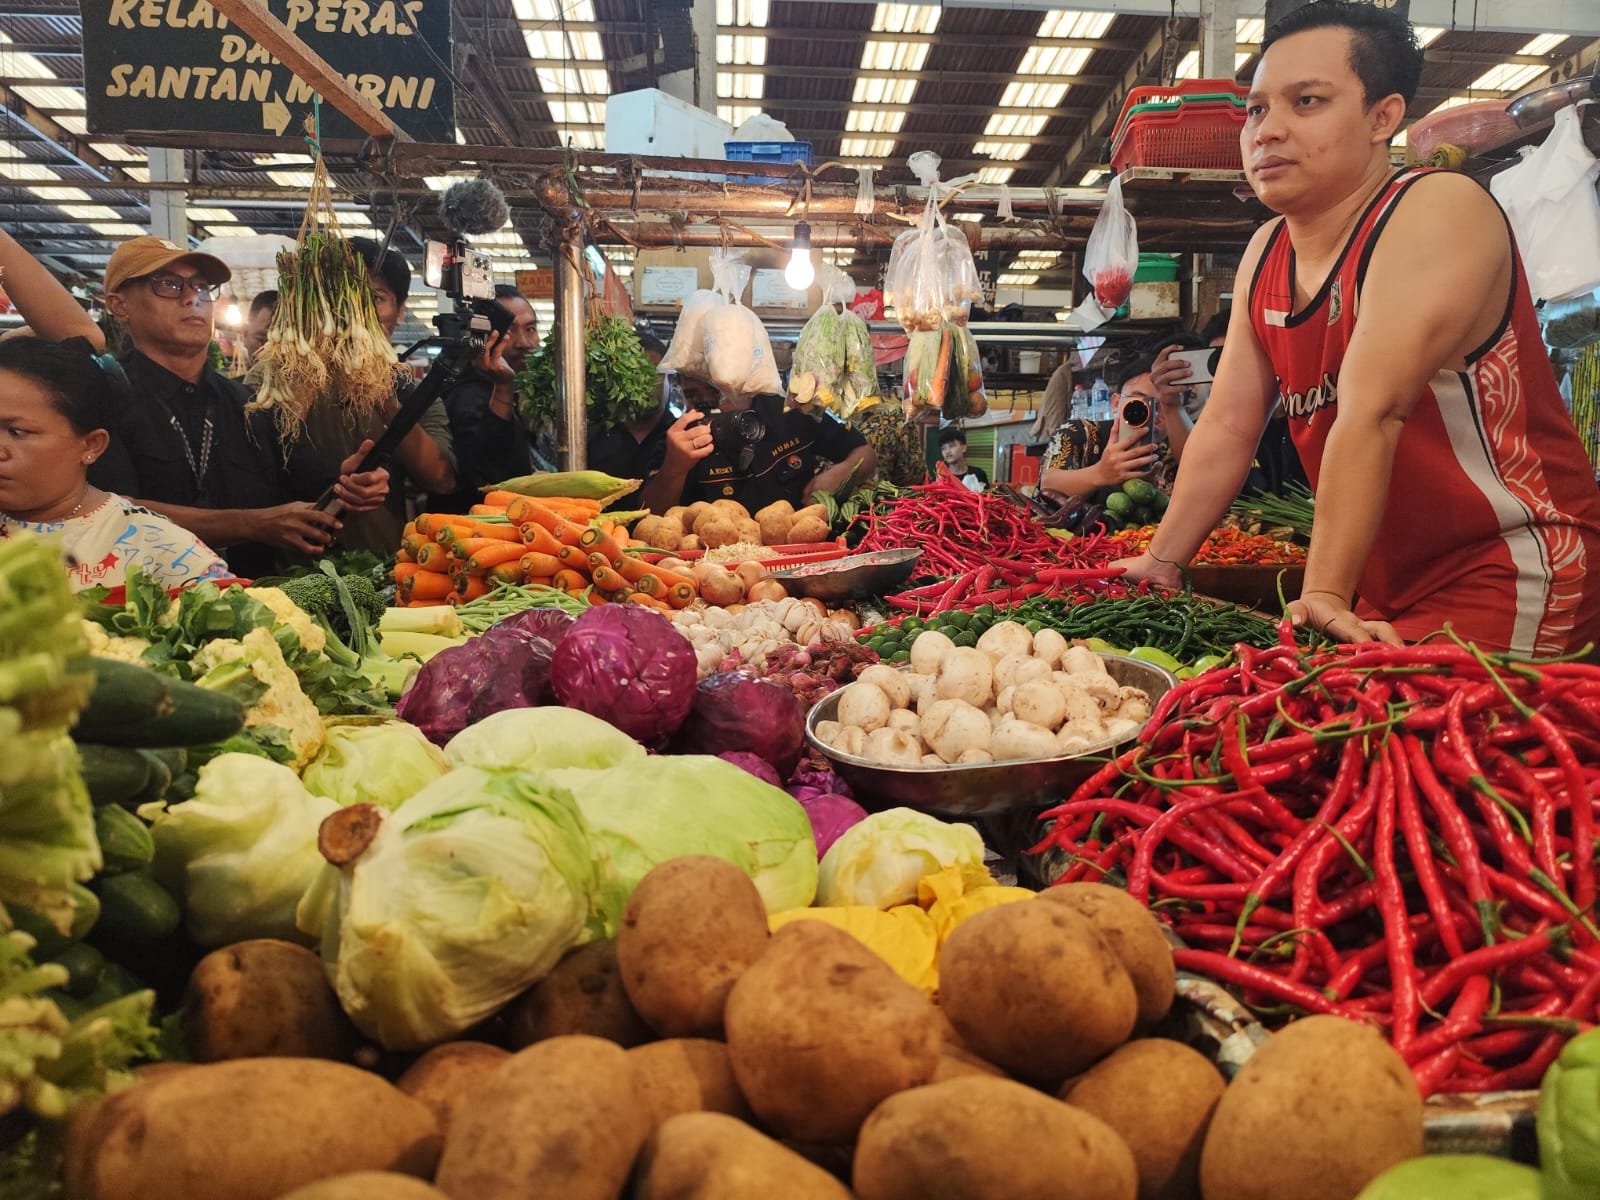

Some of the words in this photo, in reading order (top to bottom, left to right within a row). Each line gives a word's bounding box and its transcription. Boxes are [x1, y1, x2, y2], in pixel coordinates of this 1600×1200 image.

[108, 0, 268, 29] KELA
[286, 0, 423, 37] PERAS
[220, 34, 281, 65] DA
[106, 63, 272, 102] SANTAN
